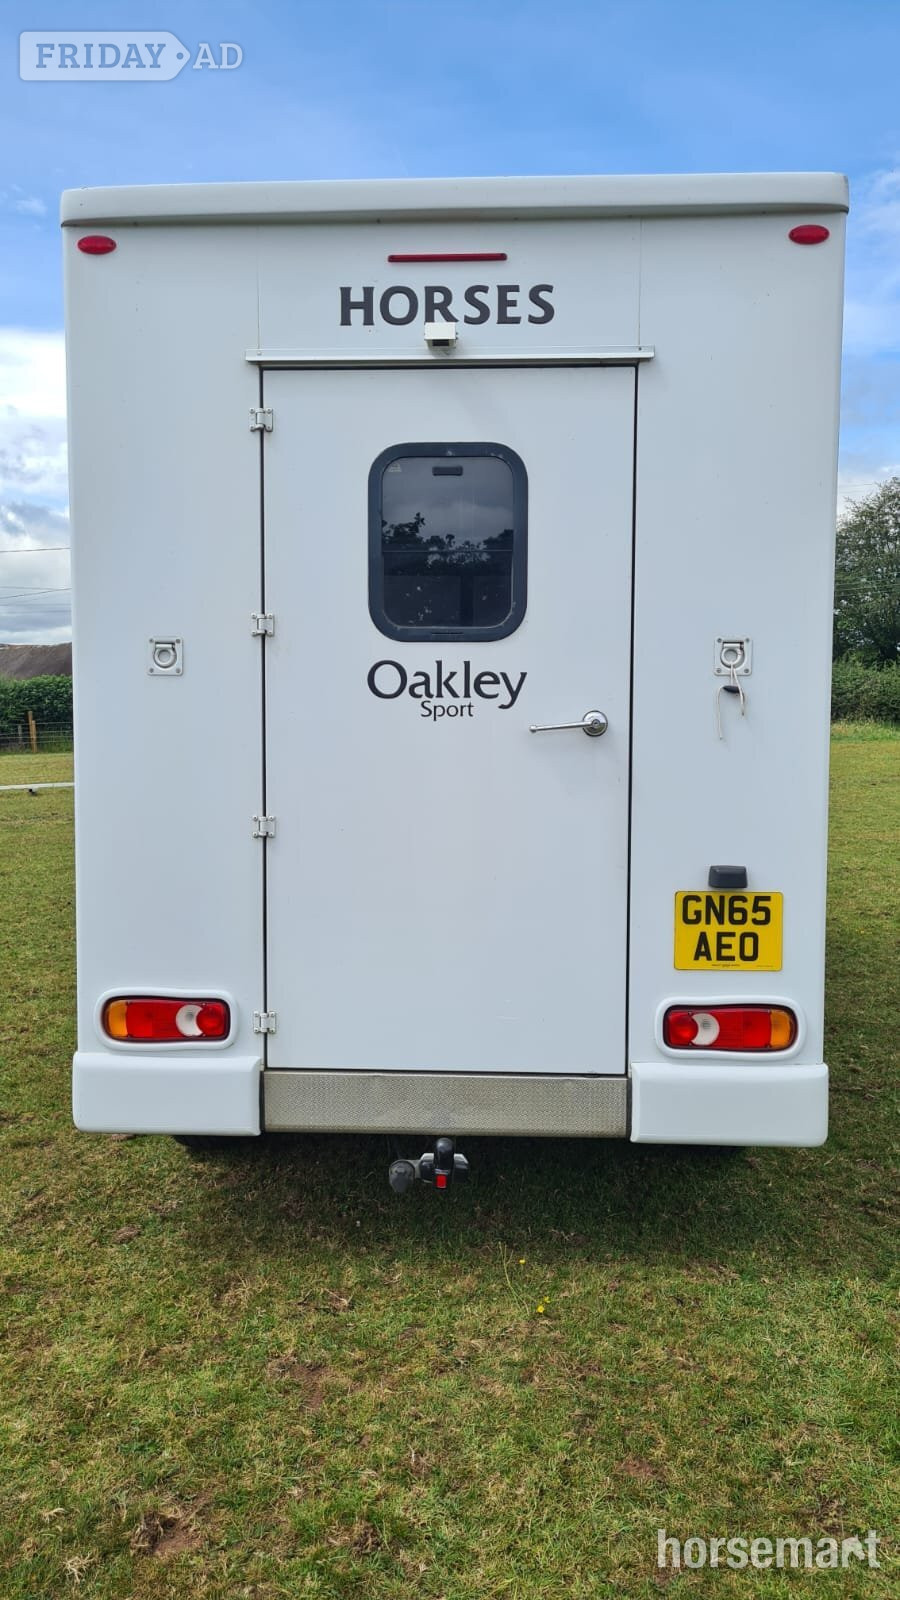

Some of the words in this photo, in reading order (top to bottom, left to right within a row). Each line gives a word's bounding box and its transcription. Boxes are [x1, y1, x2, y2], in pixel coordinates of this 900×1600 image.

[339, 284, 556, 326] HORSES
[367, 659, 528, 710] Oakley
[420, 700, 475, 721] Sport
[682, 895, 772, 926] GN65
[693, 931, 759, 962] AEO
